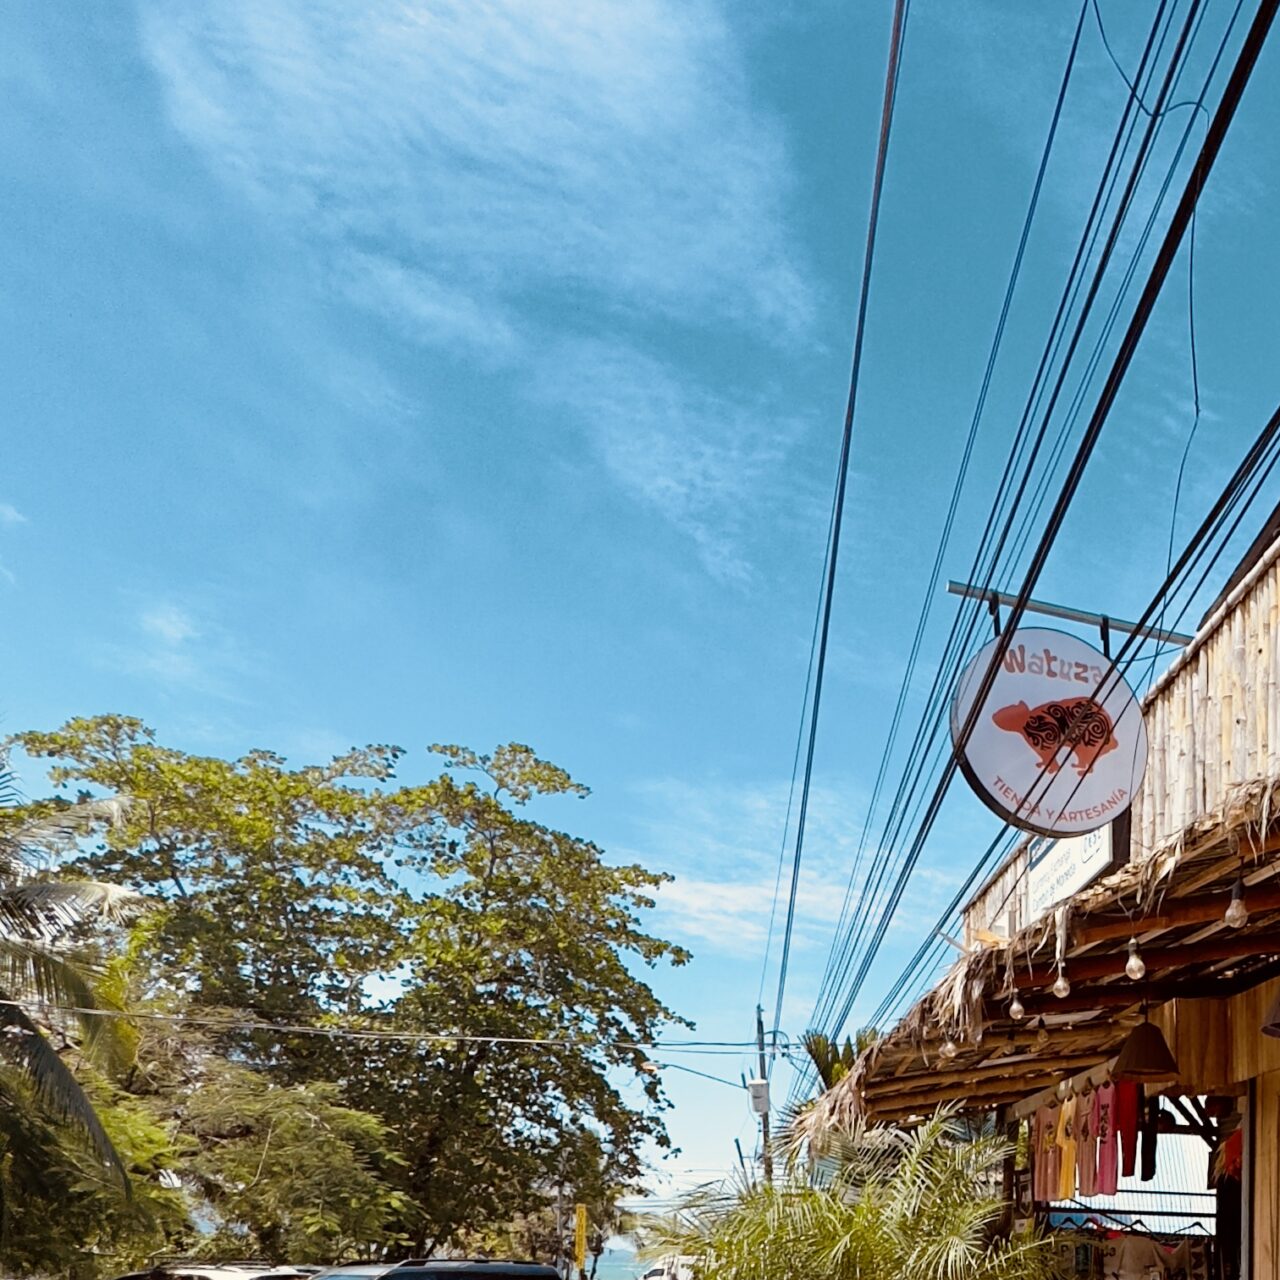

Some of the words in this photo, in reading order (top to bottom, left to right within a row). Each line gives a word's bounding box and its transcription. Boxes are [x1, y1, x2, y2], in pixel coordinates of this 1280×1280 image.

[1001, 644, 1103, 683] Watuza
[992, 775, 1042, 817] TIENDA
[1046, 808, 1055, 820] Y
